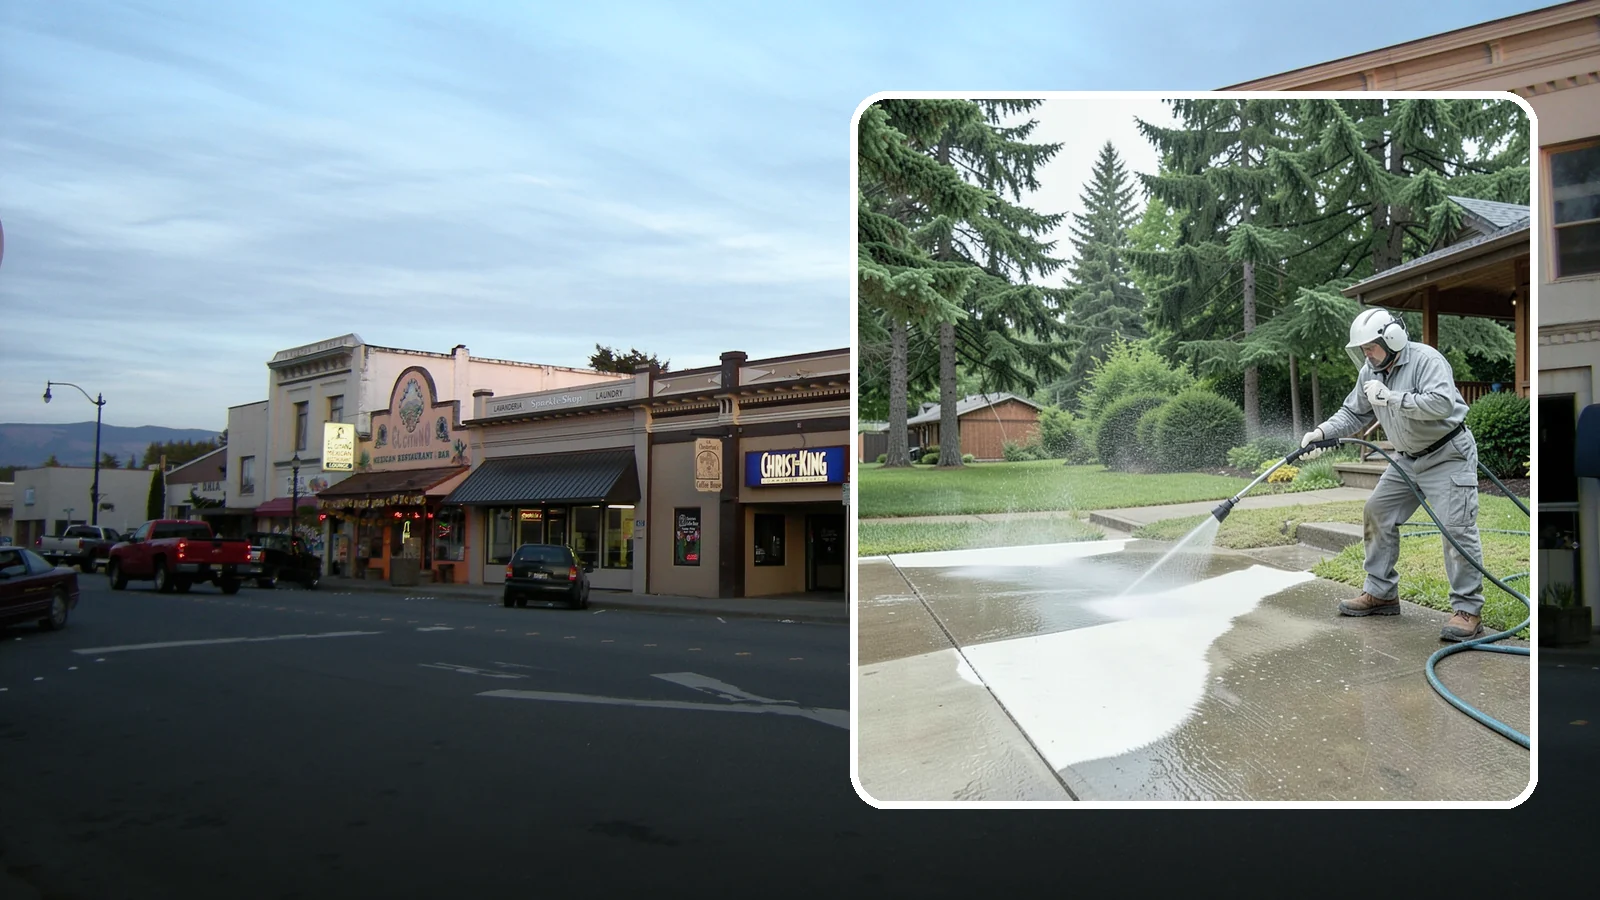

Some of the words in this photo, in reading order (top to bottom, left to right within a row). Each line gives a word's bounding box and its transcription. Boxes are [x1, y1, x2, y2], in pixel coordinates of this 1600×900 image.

[530, 397, 560, 409] Sparkle
[562, 394, 582, 407] Shop
[595, 389, 623, 400] LAUNDRY
[493, 402, 522, 413] LAVANDERIA
[373, 455, 397, 464] MEXICAN
[398, 452, 433, 462] RESTAURANT
[438, 450, 450, 458] BAR
[760, 452, 798, 478] CHRIST
[799, 449, 827, 476] KING
